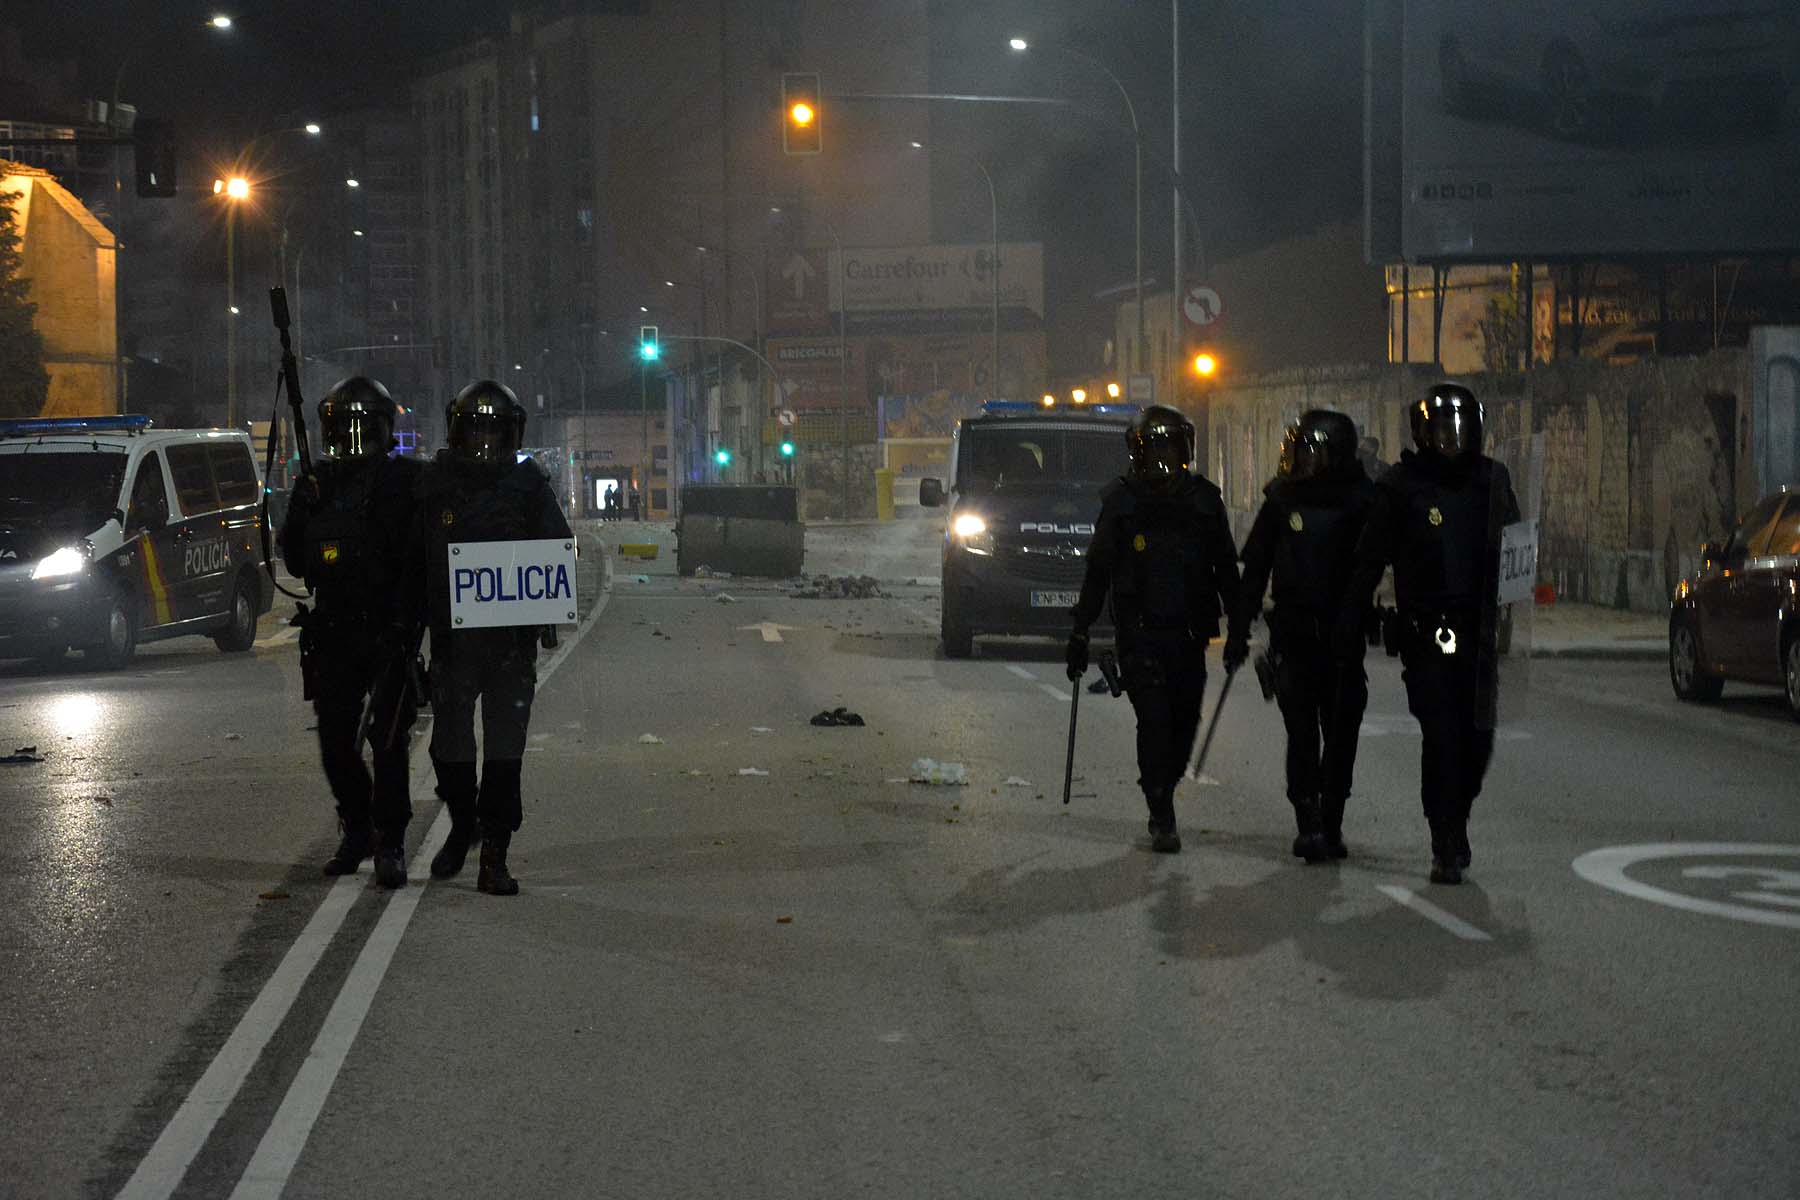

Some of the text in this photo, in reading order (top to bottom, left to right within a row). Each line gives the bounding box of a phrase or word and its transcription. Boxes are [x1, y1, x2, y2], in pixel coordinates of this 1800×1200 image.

[846, 256, 948, 280] Carrefour
[1020, 522, 1096, 534] POLICI
[455, 564, 572, 603] POLICIA
